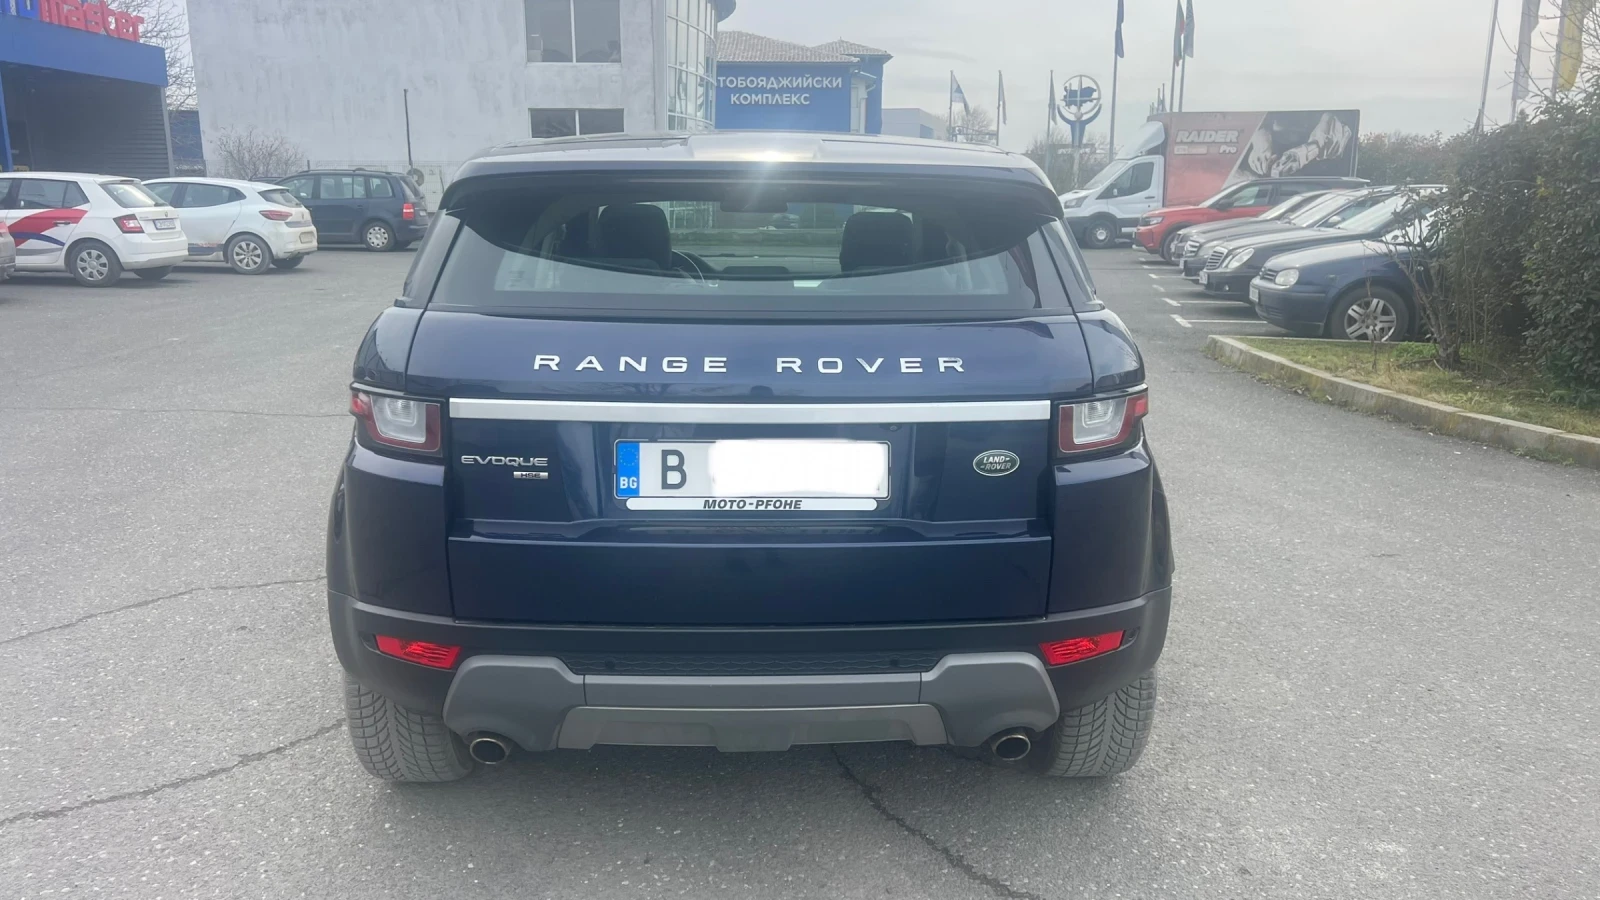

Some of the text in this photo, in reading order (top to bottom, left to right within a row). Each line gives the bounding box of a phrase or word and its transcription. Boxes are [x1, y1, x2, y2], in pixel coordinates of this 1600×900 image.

[730, 93, 810, 105] КОМПЛЕКС
[1175, 129, 1239, 143] RAIDER
[1219, 144, 1238, 154] Pro
[533, 354, 965, 374] RANGE ROVER
[461, 455, 548, 467] EVOQUE
[619, 449, 687, 490] BG B
